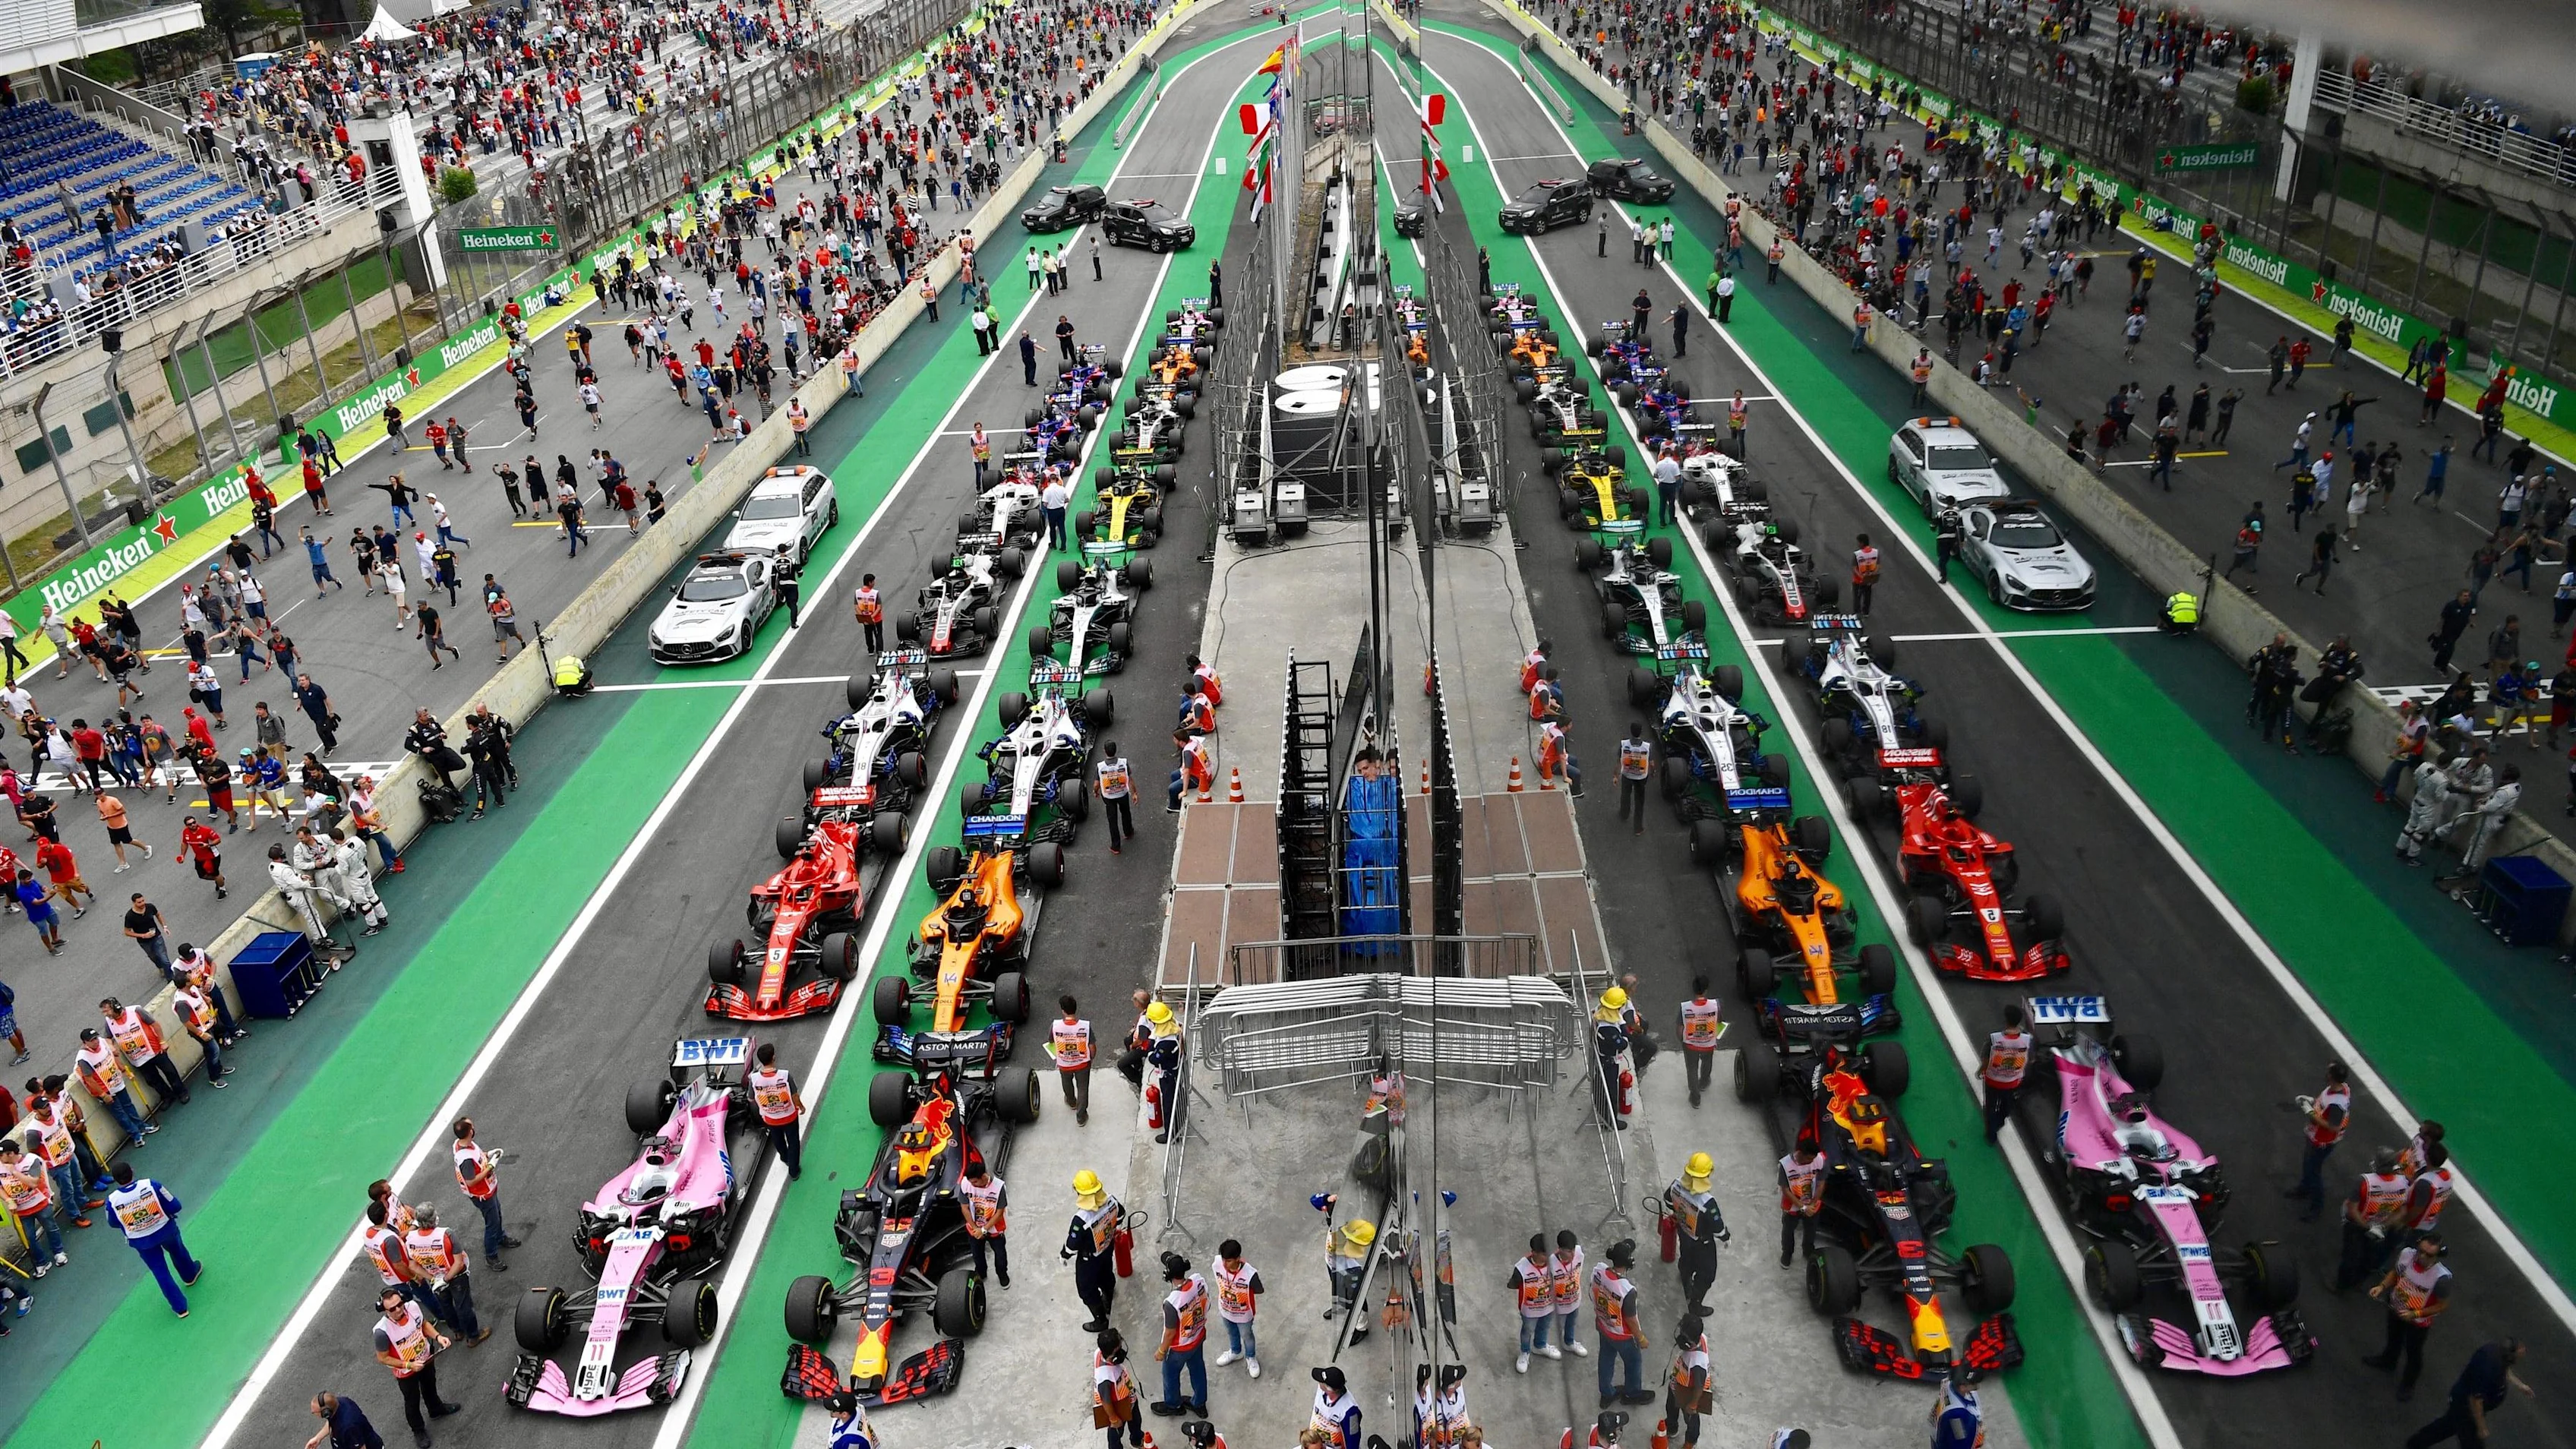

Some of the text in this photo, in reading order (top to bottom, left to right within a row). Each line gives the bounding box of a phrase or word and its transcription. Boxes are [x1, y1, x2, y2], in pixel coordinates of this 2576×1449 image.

[462, 233, 534, 248] Heineken
[440, 324, 497, 369] Heineken
[336, 378, 406, 433] Heineken
[41, 533, 153, 615] Heineken
[882, 649, 924, 658] MARTINI
[857, 762, 867, 771] 18
[820, 786, 867, 795] MISSION
[1015, 788, 1028, 797] 35
[971, 814, 1021, 822] CHANDON
[772, 949, 781, 961] 5
[683, 1039, 743, 1061] BWT
[953, 1042, 987, 1050] MARTIN
[870, 1267, 895, 1286] 3
[598, 1289, 626, 1299] BWT
[591, 1344, 605, 1362] 11
[582, 1364, 597, 1394] HYPE
